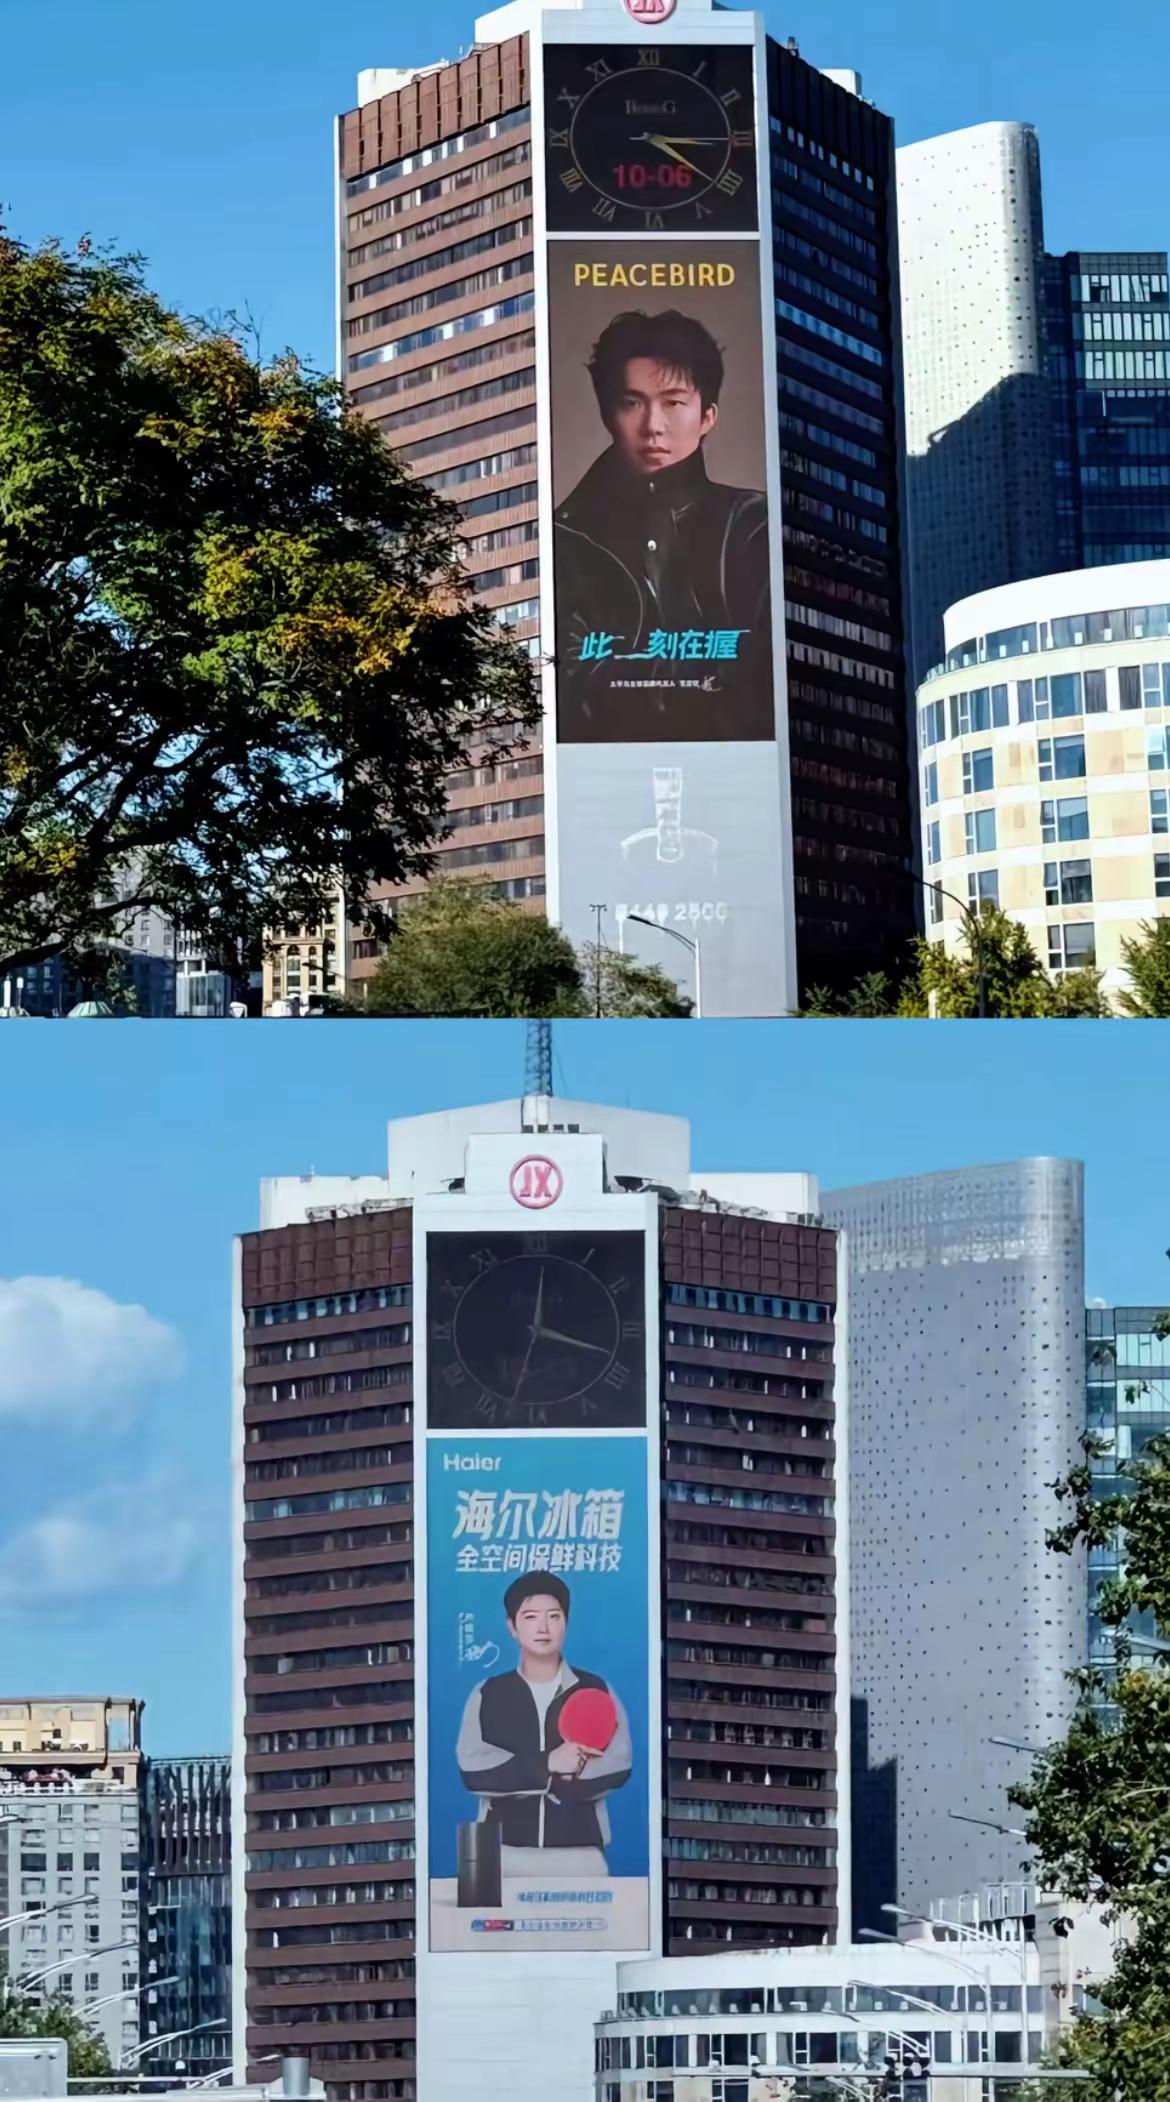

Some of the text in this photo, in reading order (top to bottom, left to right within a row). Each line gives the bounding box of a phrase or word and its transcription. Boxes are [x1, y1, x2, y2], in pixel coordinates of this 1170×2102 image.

[637, 49, 660, 66] XII
[558, 88, 581, 109] X
[613, 163, 692, 188] 10-06
[574, 263, 735, 287] PEACEBIRD
[578, 628, 751, 661] 此一刻在握
[443, 1453, 501, 1471] Haier
[452, 1488, 625, 1541] 海尔冰箱
[455, 1543, 623, 1573] 全空间保鲜科技
